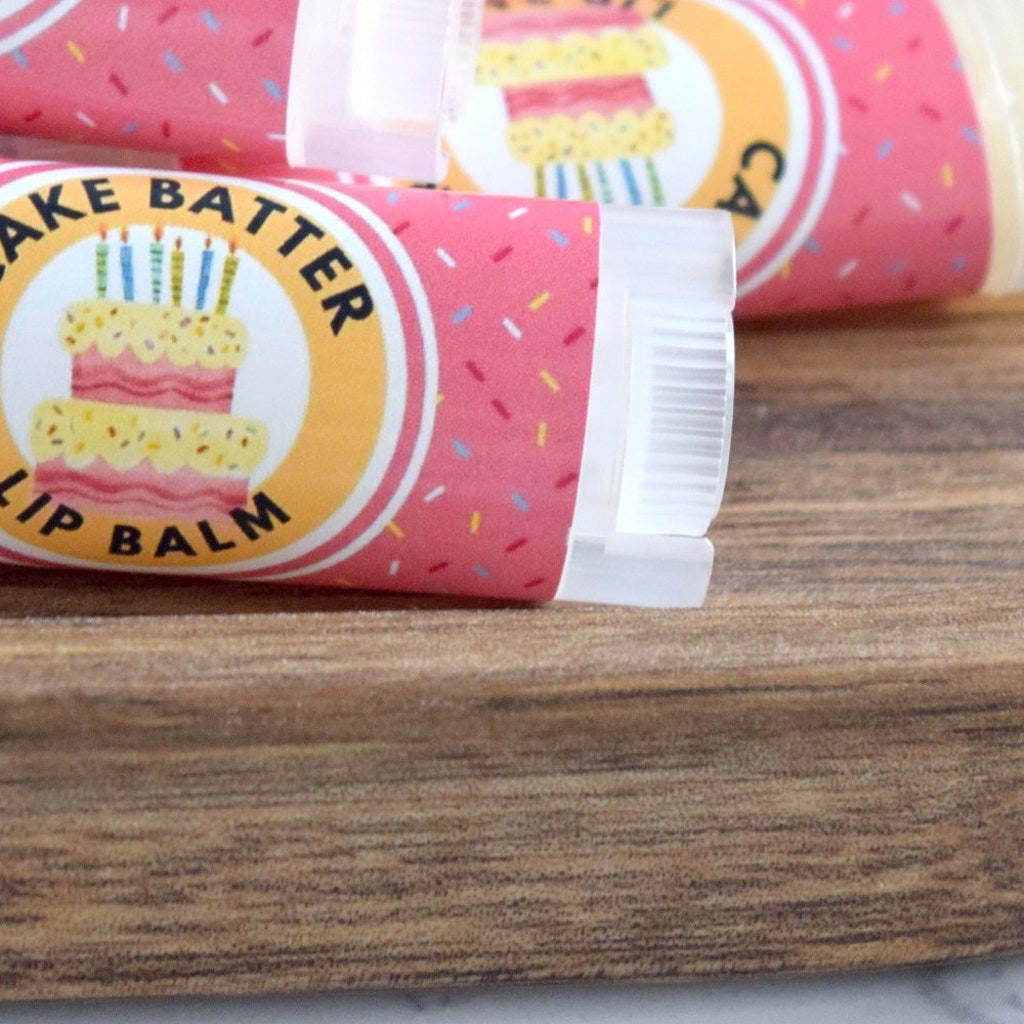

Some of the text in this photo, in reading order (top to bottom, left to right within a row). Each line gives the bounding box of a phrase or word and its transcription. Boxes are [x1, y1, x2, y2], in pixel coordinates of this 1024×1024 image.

[715, 140, 787, 220] CA
[149, 177, 375, 336] BATTER
[109, 492, 292, 558] BALM
